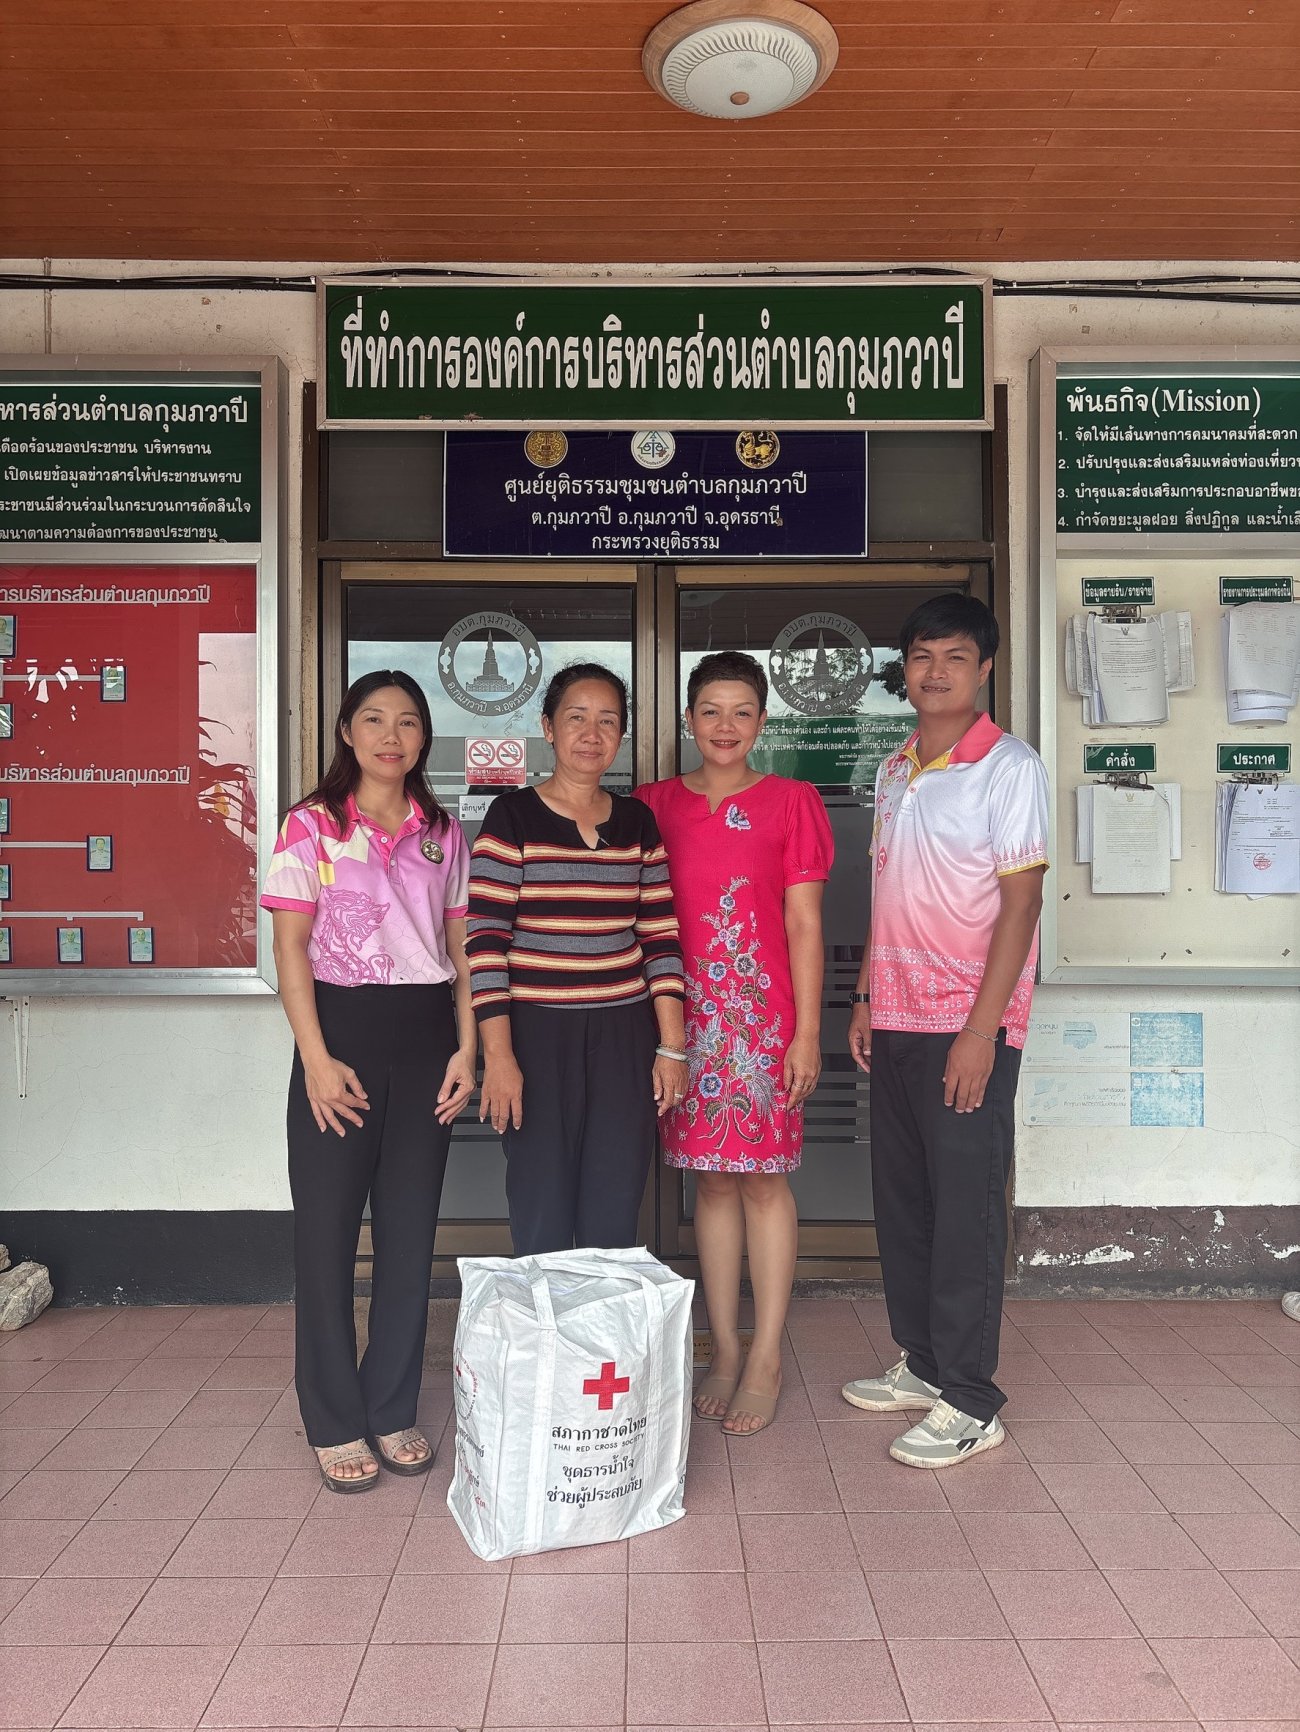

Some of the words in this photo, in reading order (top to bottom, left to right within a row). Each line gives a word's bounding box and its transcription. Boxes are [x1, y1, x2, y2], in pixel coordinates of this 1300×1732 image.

[341, 296, 963, 414] ที่ทำการองค์การบริหารส่วนตำบลกุมภวาปี
[1067, 386, 1260, 417] พันธกิจ(Mission)
[1057, 430, 1068, 441] 1.
[1075, 420, 1298, 442] จัดให้มีเส้นทางการคมนาคมที่สะดวก
[0, 437, 138, 454] ดือดร้อนของประชาชน
[144, 439, 212, 455] บริหารงาน
[1058, 459, 1069, 469] 2.
[4, 465, 242, 488] เปิดเผยข้อมูลข่าวสารให้ประชาชนทราบ
[504, 471, 807, 502] ศูนย์ยุติธรรมชุมชนตำบลกุมภวาปี
[1057, 488, 1068, 498] 3.
[532, 505, 611, 531] ต.กุมภวาปี
[618, 505, 697, 531] อ.กุมภวาปี
[704, 505, 780, 531] จ.อุดรธานี
[1058, 517, 1069, 527] 4.
[1076, 511, 1178, 532] กำจัดขยะมูลฝอย
[1185, 507, 1239, 531] สิ่งปฏิกูล
[592, 531, 720, 556] กระทรวงยุติธรรม
[452, 615, 527, 637] อบต.กุมภวาปี
[783, 615, 858, 638] อบต.กุมภวาปี
[1106, 750, 1136, 767] คำสั่ง
[1233, 753, 1276, 765] ประกาศ
[551, 1416, 647, 1441] สภากาชาดไทย
[553, 1443, 571, 1452] THAI
[594, 1441, 618, 1451] CROSS
[562, 1454, 635, 1484] ชุดธารน้ำใจ
[546, 1475, 642, 1509] ช่วยผู้ประสบภัย
